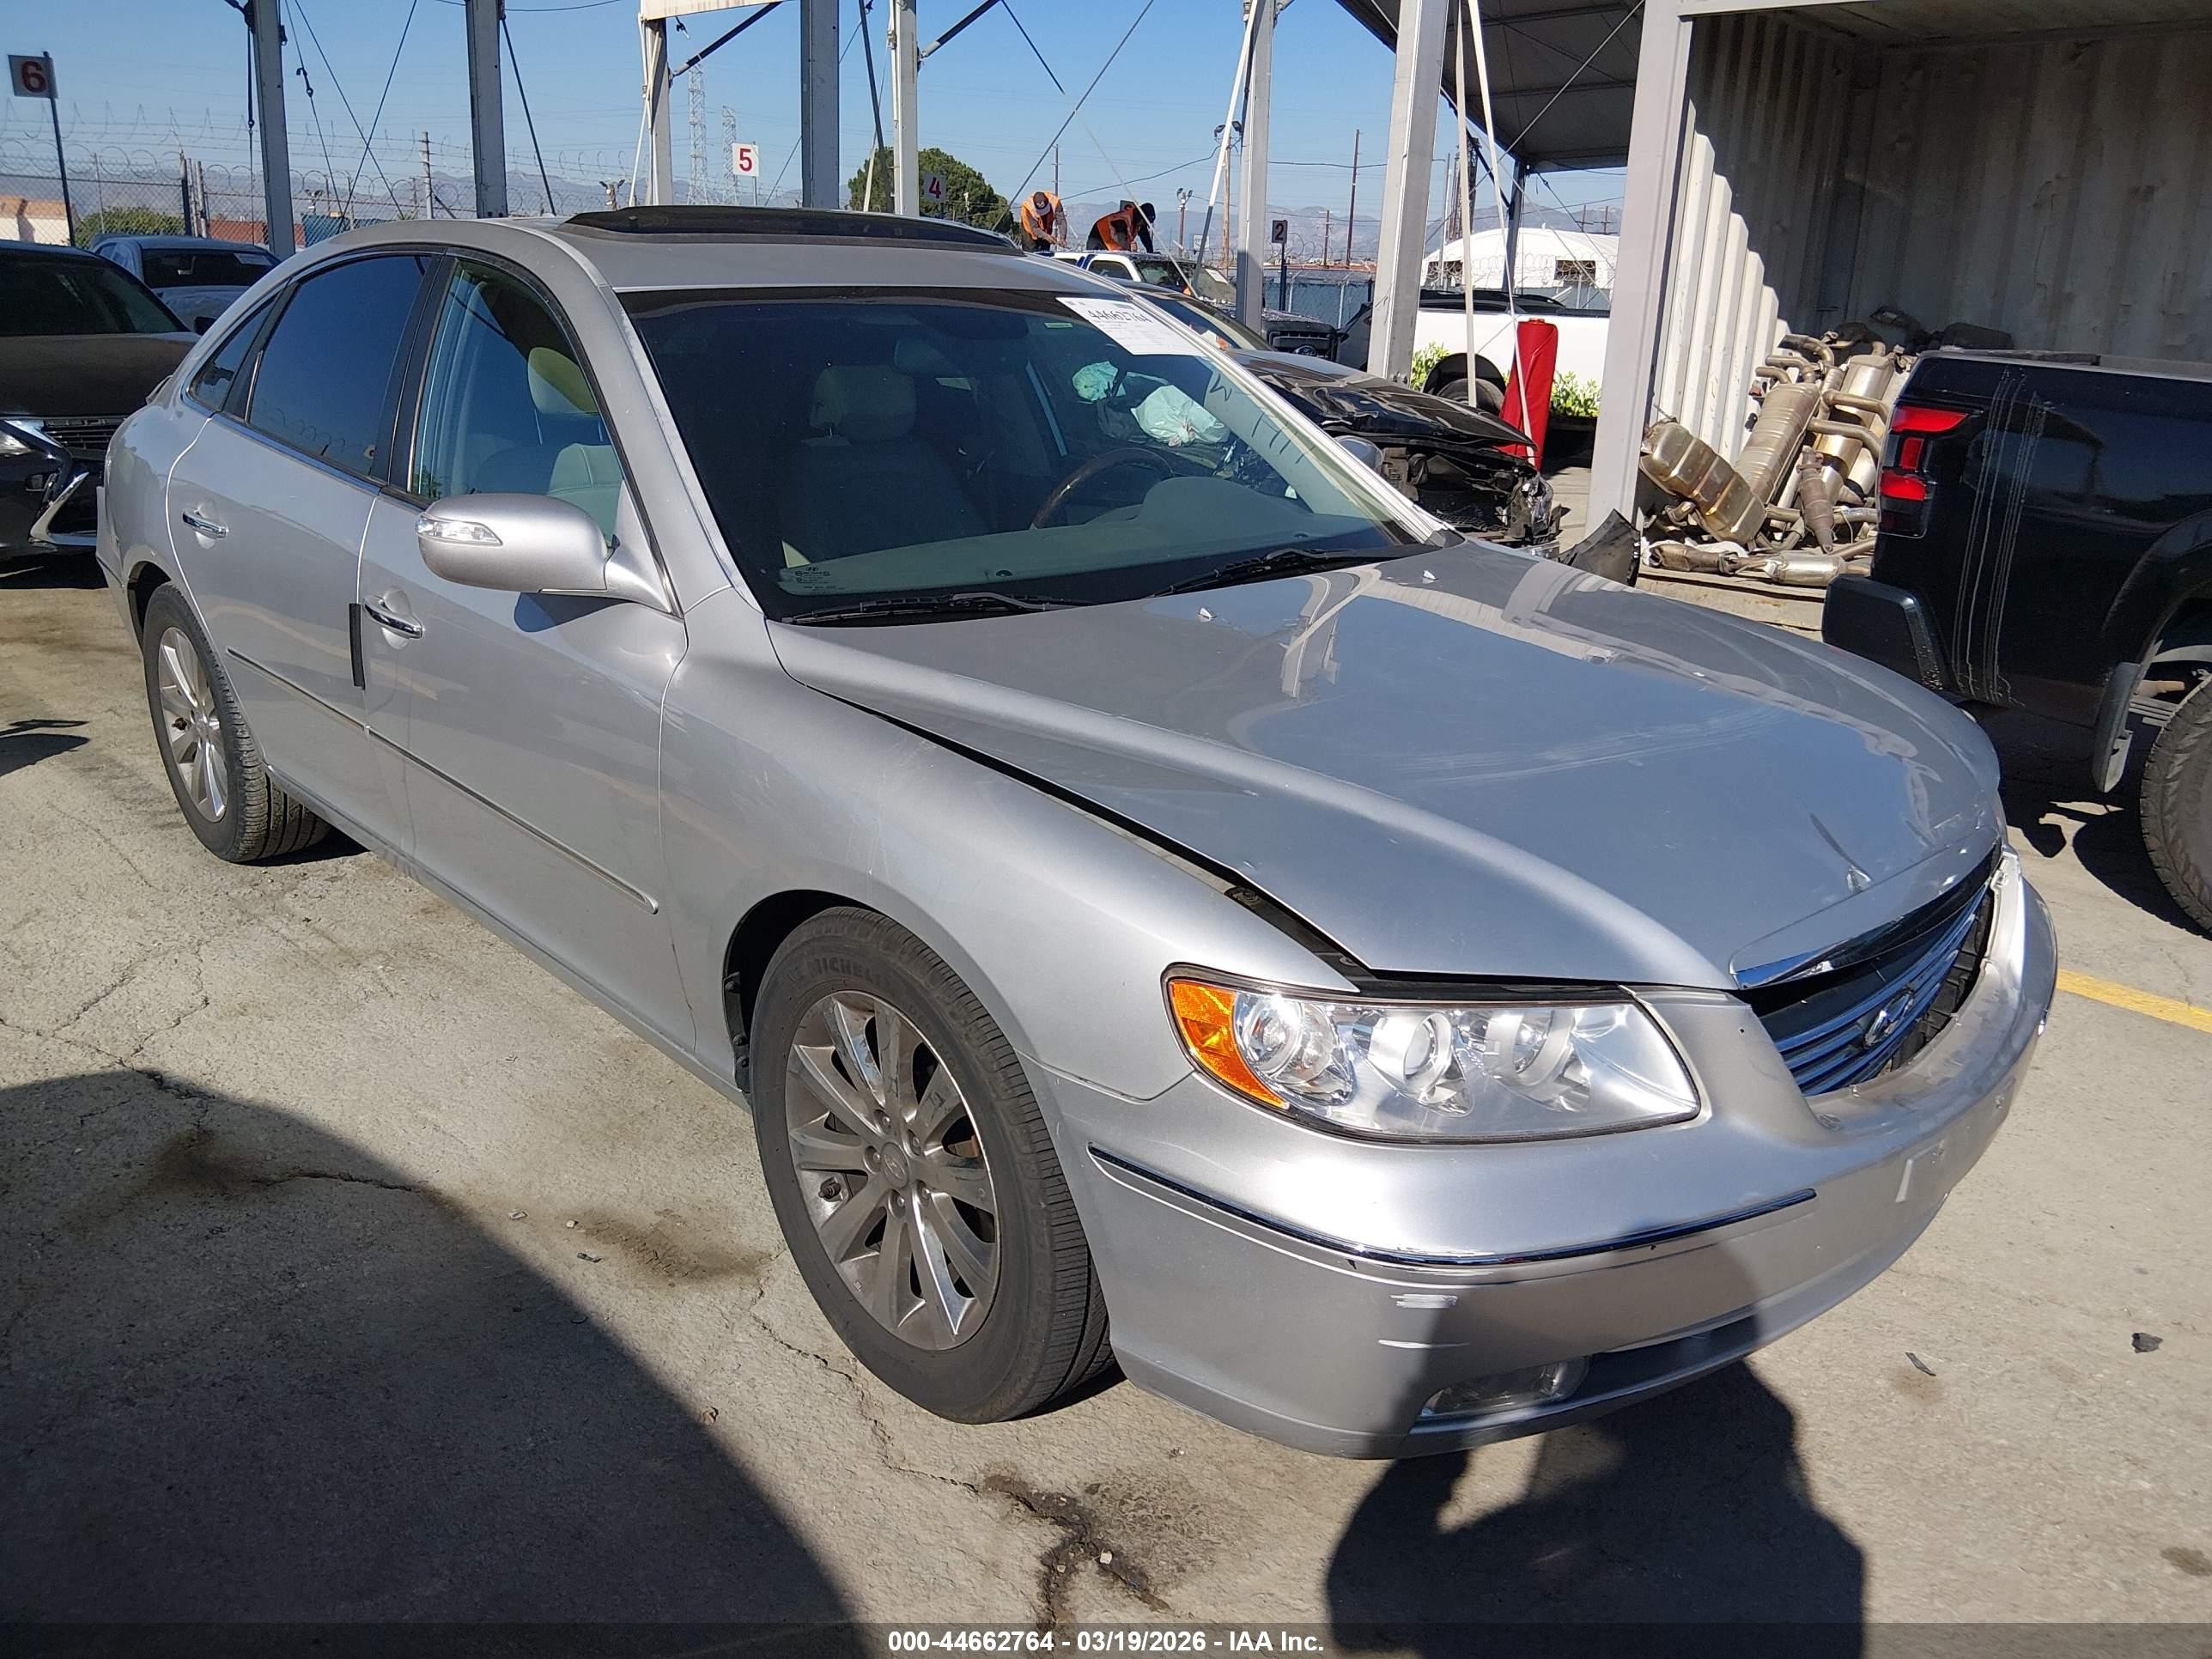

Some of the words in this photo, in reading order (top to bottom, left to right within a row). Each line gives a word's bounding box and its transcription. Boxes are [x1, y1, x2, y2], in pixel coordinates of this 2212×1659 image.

[21, 61, 46, 93] 6
[739, 148, 752, 172] 5
[928, 177, 941, 198] 4
[1275, 223, 1285, 241] 2
[807, 956, 883, 985] MICHEL
